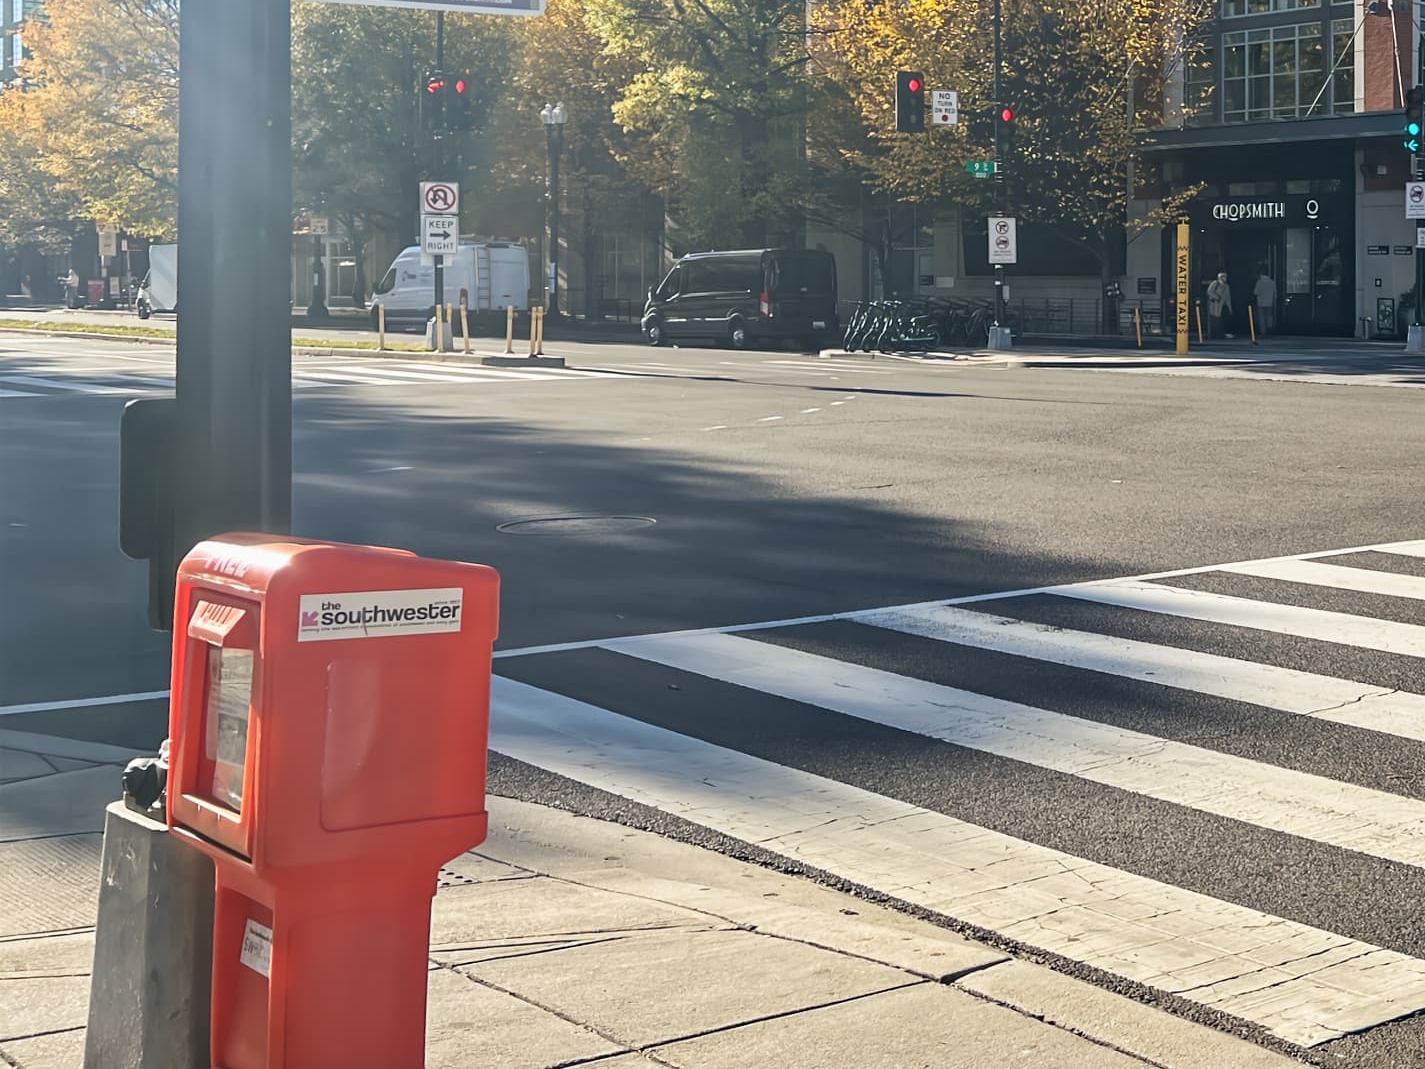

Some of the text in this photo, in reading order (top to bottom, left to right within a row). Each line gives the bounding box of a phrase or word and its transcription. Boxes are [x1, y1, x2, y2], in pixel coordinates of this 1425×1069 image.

[939, 92, 951, 100] NO
[1212, 202, 1285, 221] CHOPSMITH
[429, 220, 454, 229] KEEP
[428, 242, 454, 250] RIGHT
[1178, 254, 1187, 325] WATER TAXI
[321, 601, 341, 611] the
[321, 603, 461, 626] southwester
